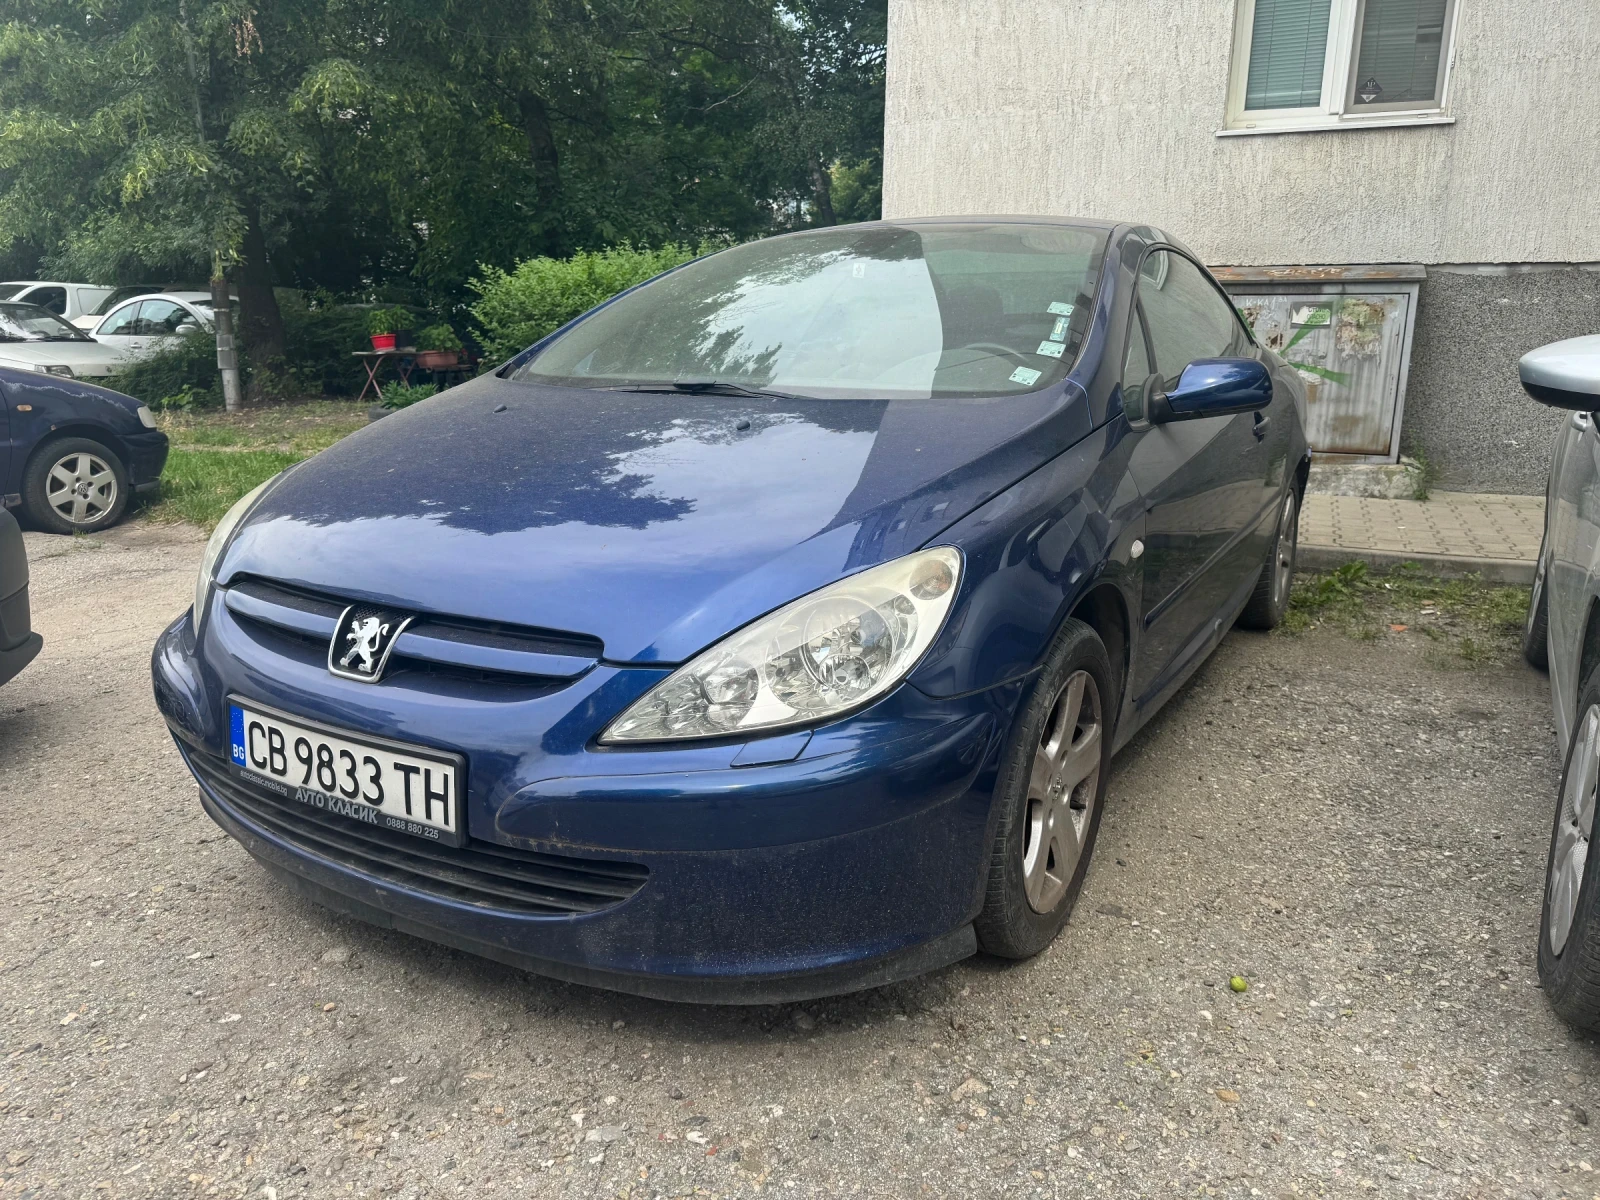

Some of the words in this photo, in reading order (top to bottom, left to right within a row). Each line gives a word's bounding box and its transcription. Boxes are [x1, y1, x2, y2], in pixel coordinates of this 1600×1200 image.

[232, 743, 245, 760] BG
[249, 721, 288, 777] CB
[294, 736, 385, 806] 9833
[393, 761, 450, 827] TH
[295, 787, 325, 808] АУТО
[328, 796, 378, 824] КЛАСИК
[386, 817, 406, 830] 0888
[407, 822, 422, 835] 880
[424, 826, 439, 839] 225
